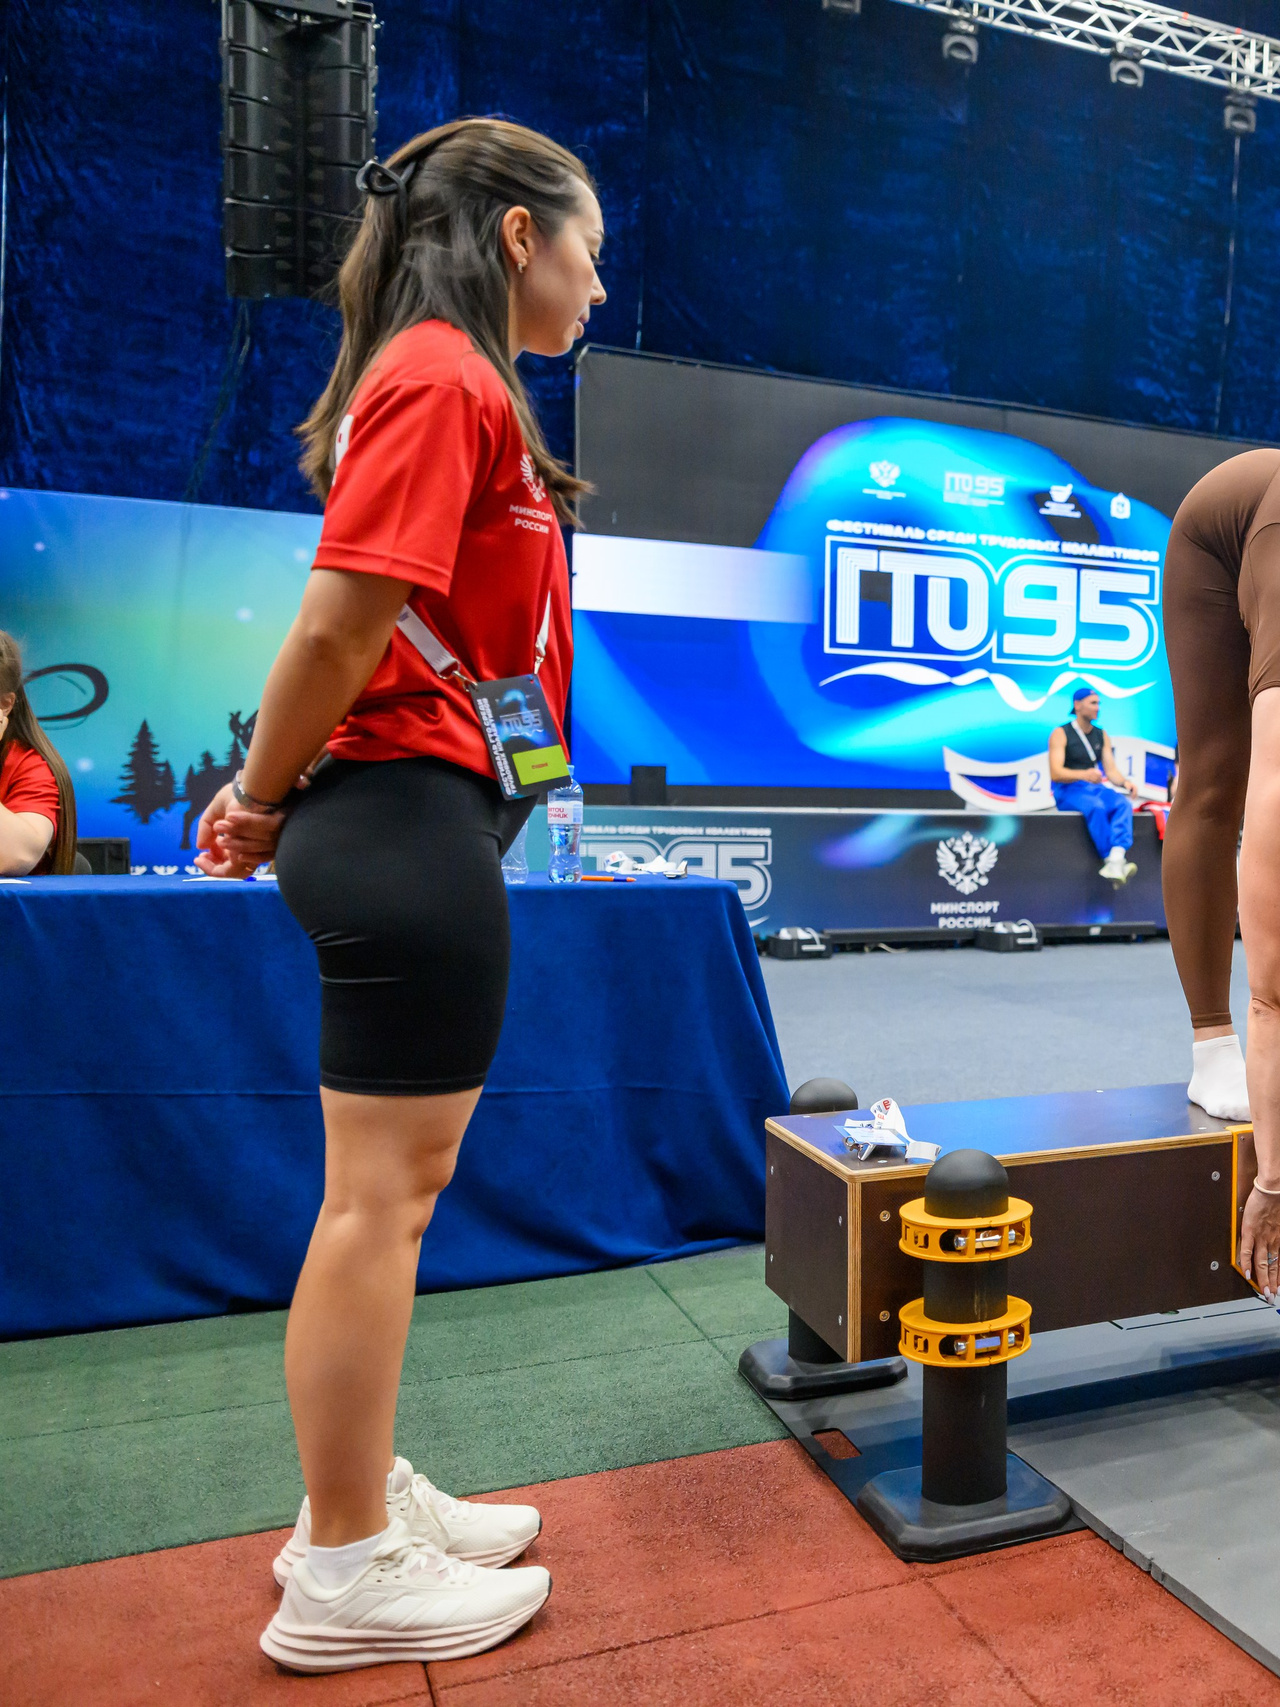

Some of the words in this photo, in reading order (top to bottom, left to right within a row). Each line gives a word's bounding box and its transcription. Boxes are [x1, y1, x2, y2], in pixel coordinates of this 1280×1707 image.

[514, 518, 550, 534] РОССИИ
[826, 519, 926, 541] ФЕСТИВАЛЬ
[926, 529, 977, 545] СРЕДИ
[978, 534, 1061, 553] ТРУДОВЫХ
[1061, 541, 1160, 563] КОЛЛЕКТИВОВ
[1125, 754, 1135, 778] 1
[1028, 769, 1042, 793] 2
[930, 900, 1000, 915] МИНСПОРТ
[938, 916, 991, 929] РОССИИ
